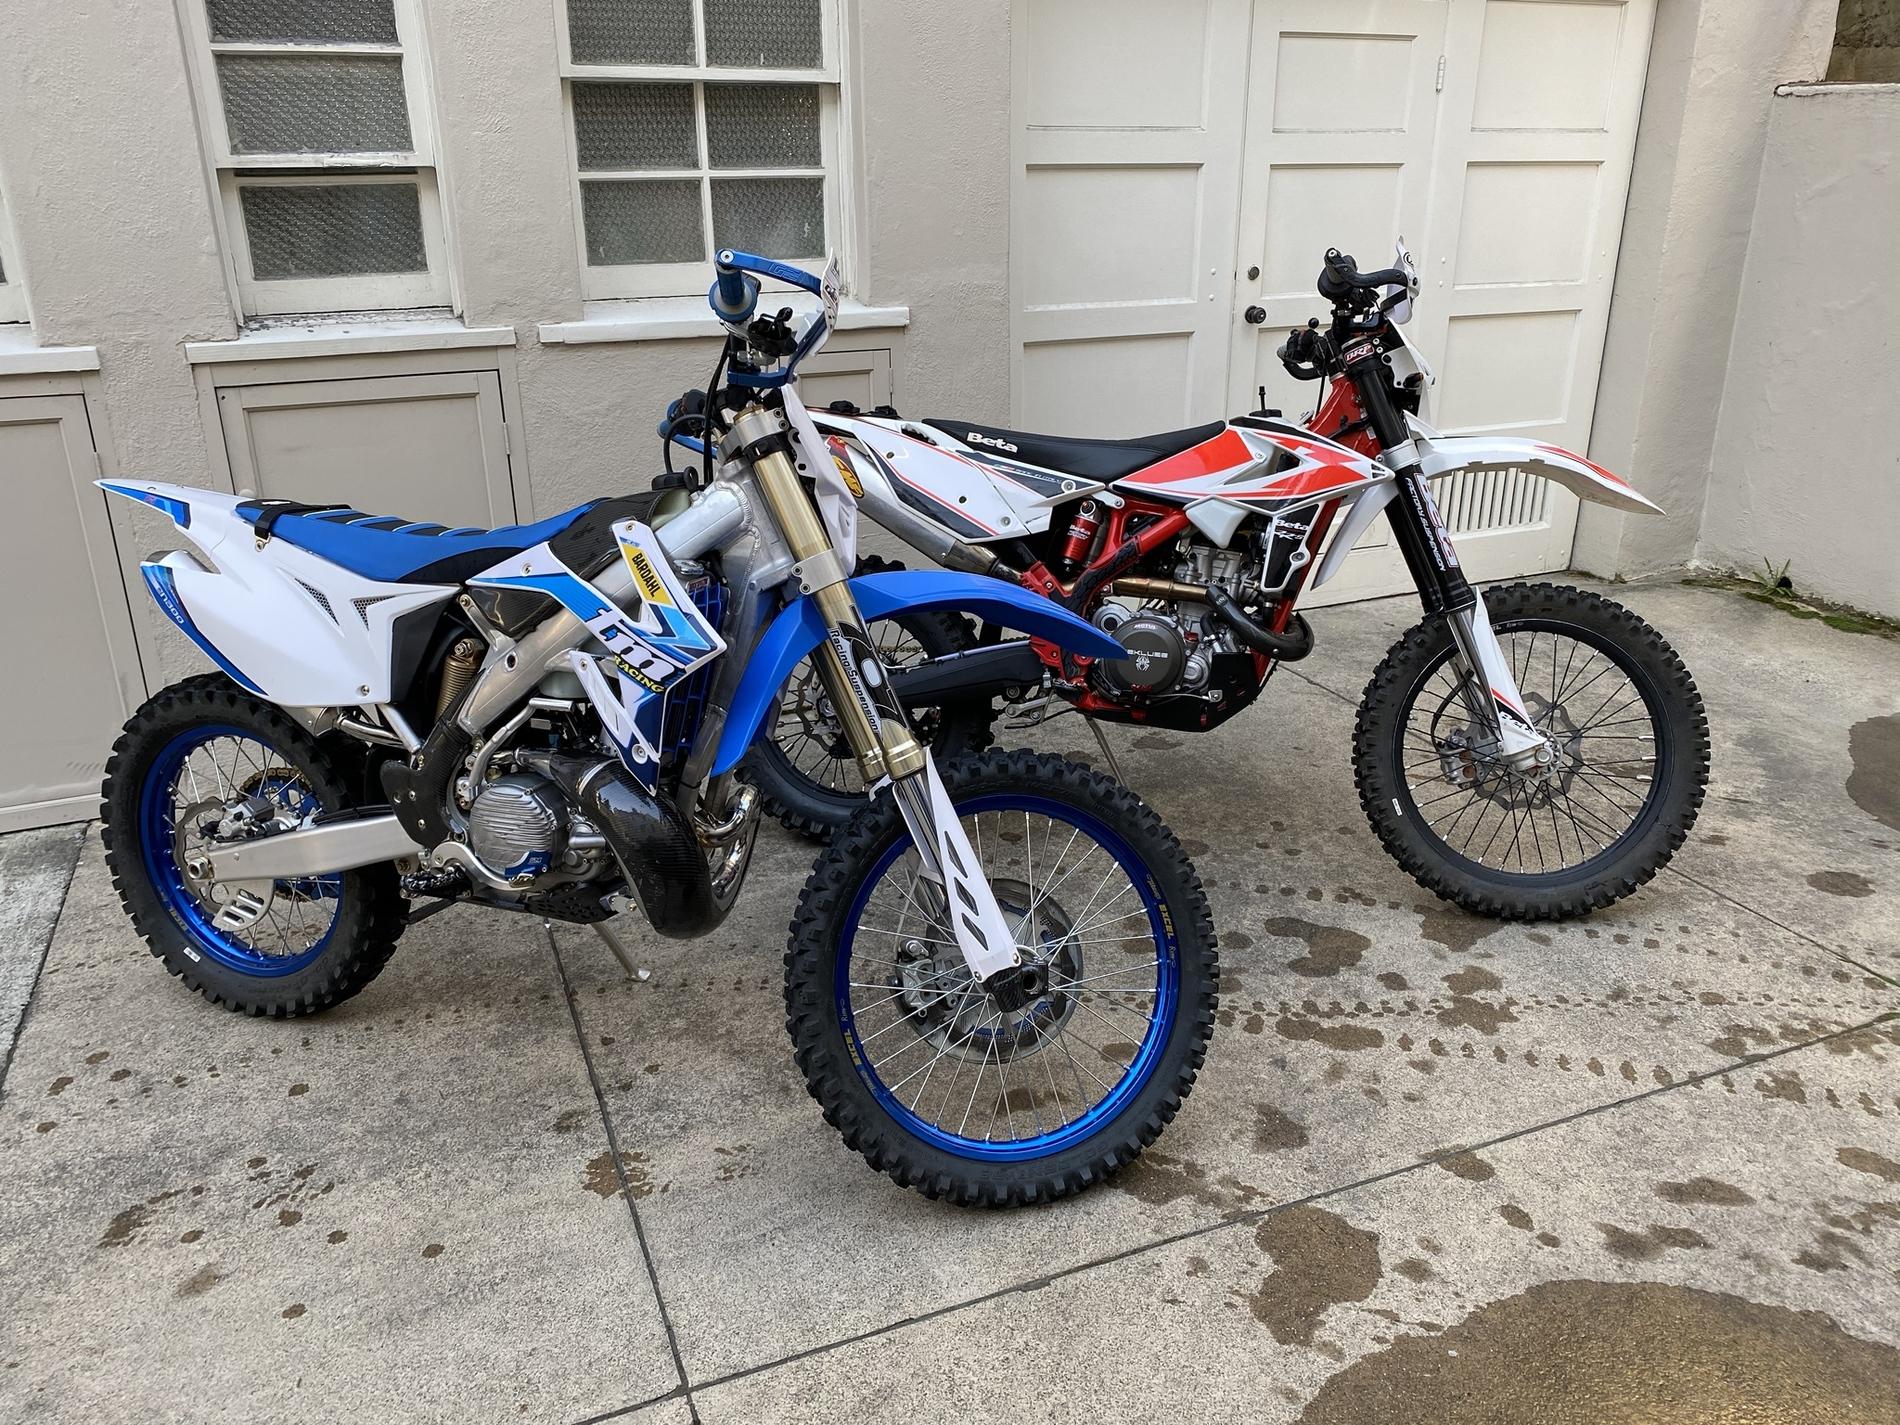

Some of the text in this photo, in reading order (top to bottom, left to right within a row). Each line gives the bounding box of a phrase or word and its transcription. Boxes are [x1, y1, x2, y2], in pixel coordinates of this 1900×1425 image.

[967, 432, 1018, 453] Beta
[1275, 519, 1309, 530] Beta
[1405, 477, 1447, 572] FACTORY SUSPENSION
[632, 553, 661, 597] BARDAHL
[1127, 649, 1168, 658] EKLUSE
[614, 655, 665, 692] RACING
[830, 629, 880, 734] Racing Suspension
[1159, 904, 1175, 939] EXCEL
[844, 1028, 862, 1066] EXCEL
